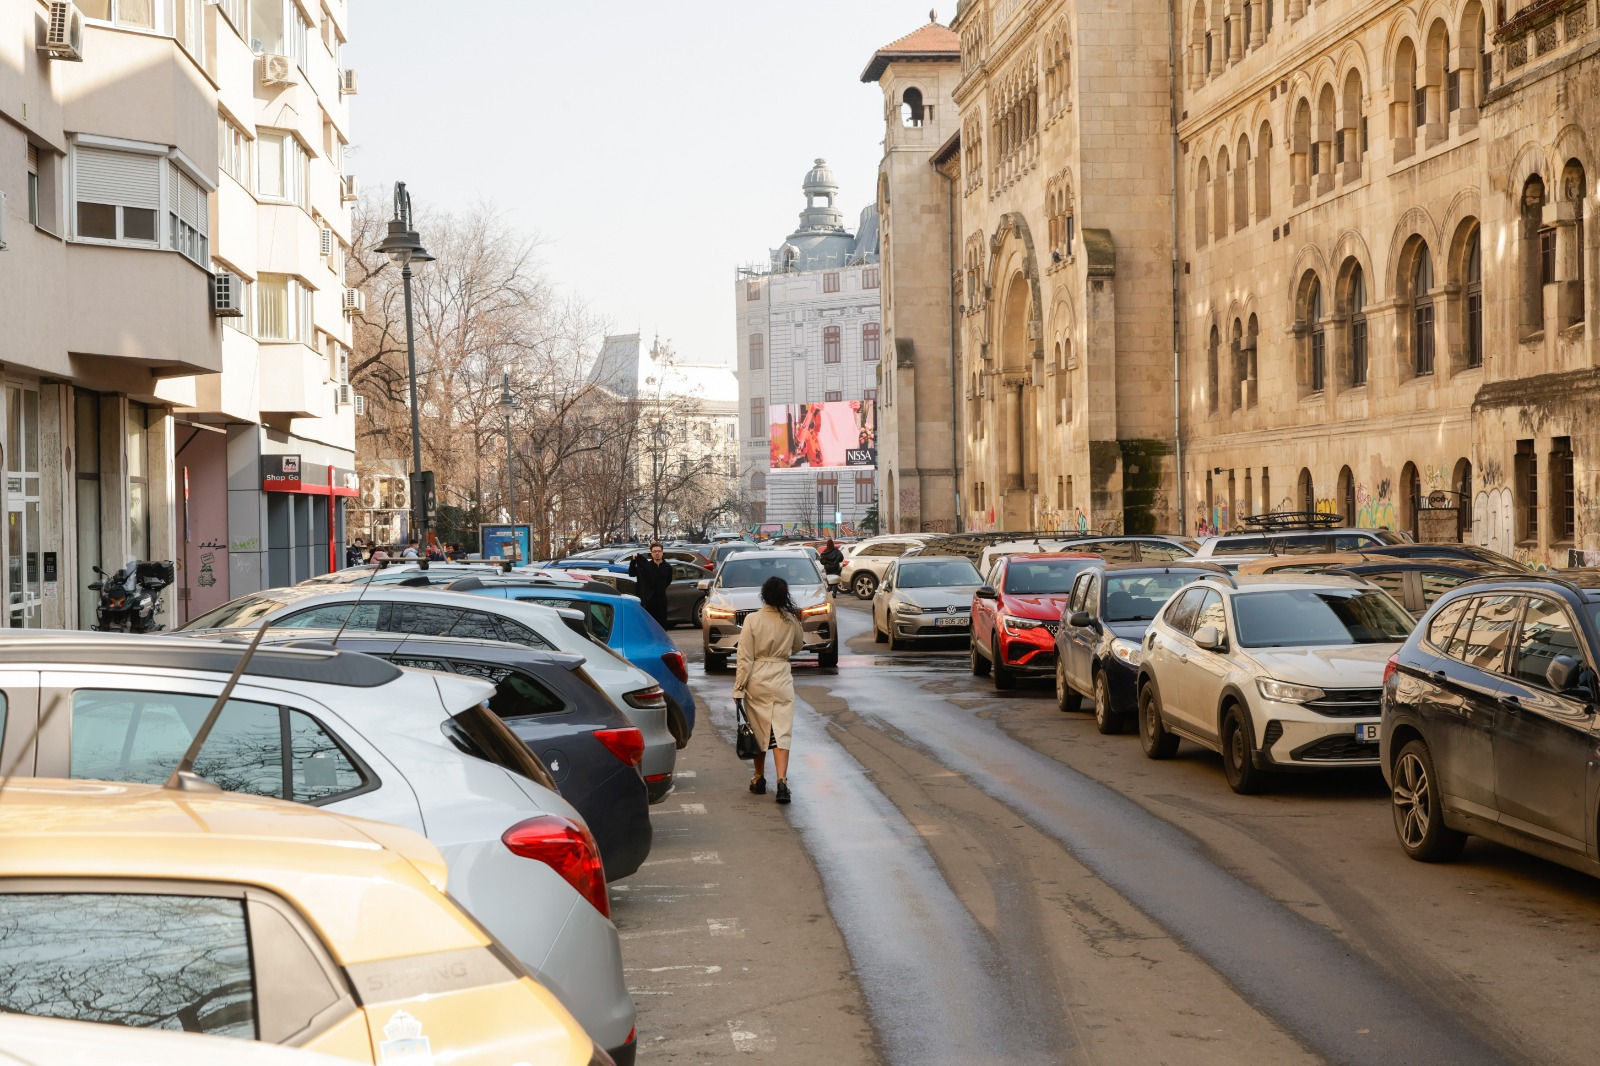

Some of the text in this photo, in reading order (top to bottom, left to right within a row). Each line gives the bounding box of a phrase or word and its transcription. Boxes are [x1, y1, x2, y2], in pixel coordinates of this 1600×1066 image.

[847, 450, 872, 461] NISSA
[266, 474, 285, 482] Shop
[1431, 494, 1446, 503] océ
[1367, 726, 1377, 738] B
